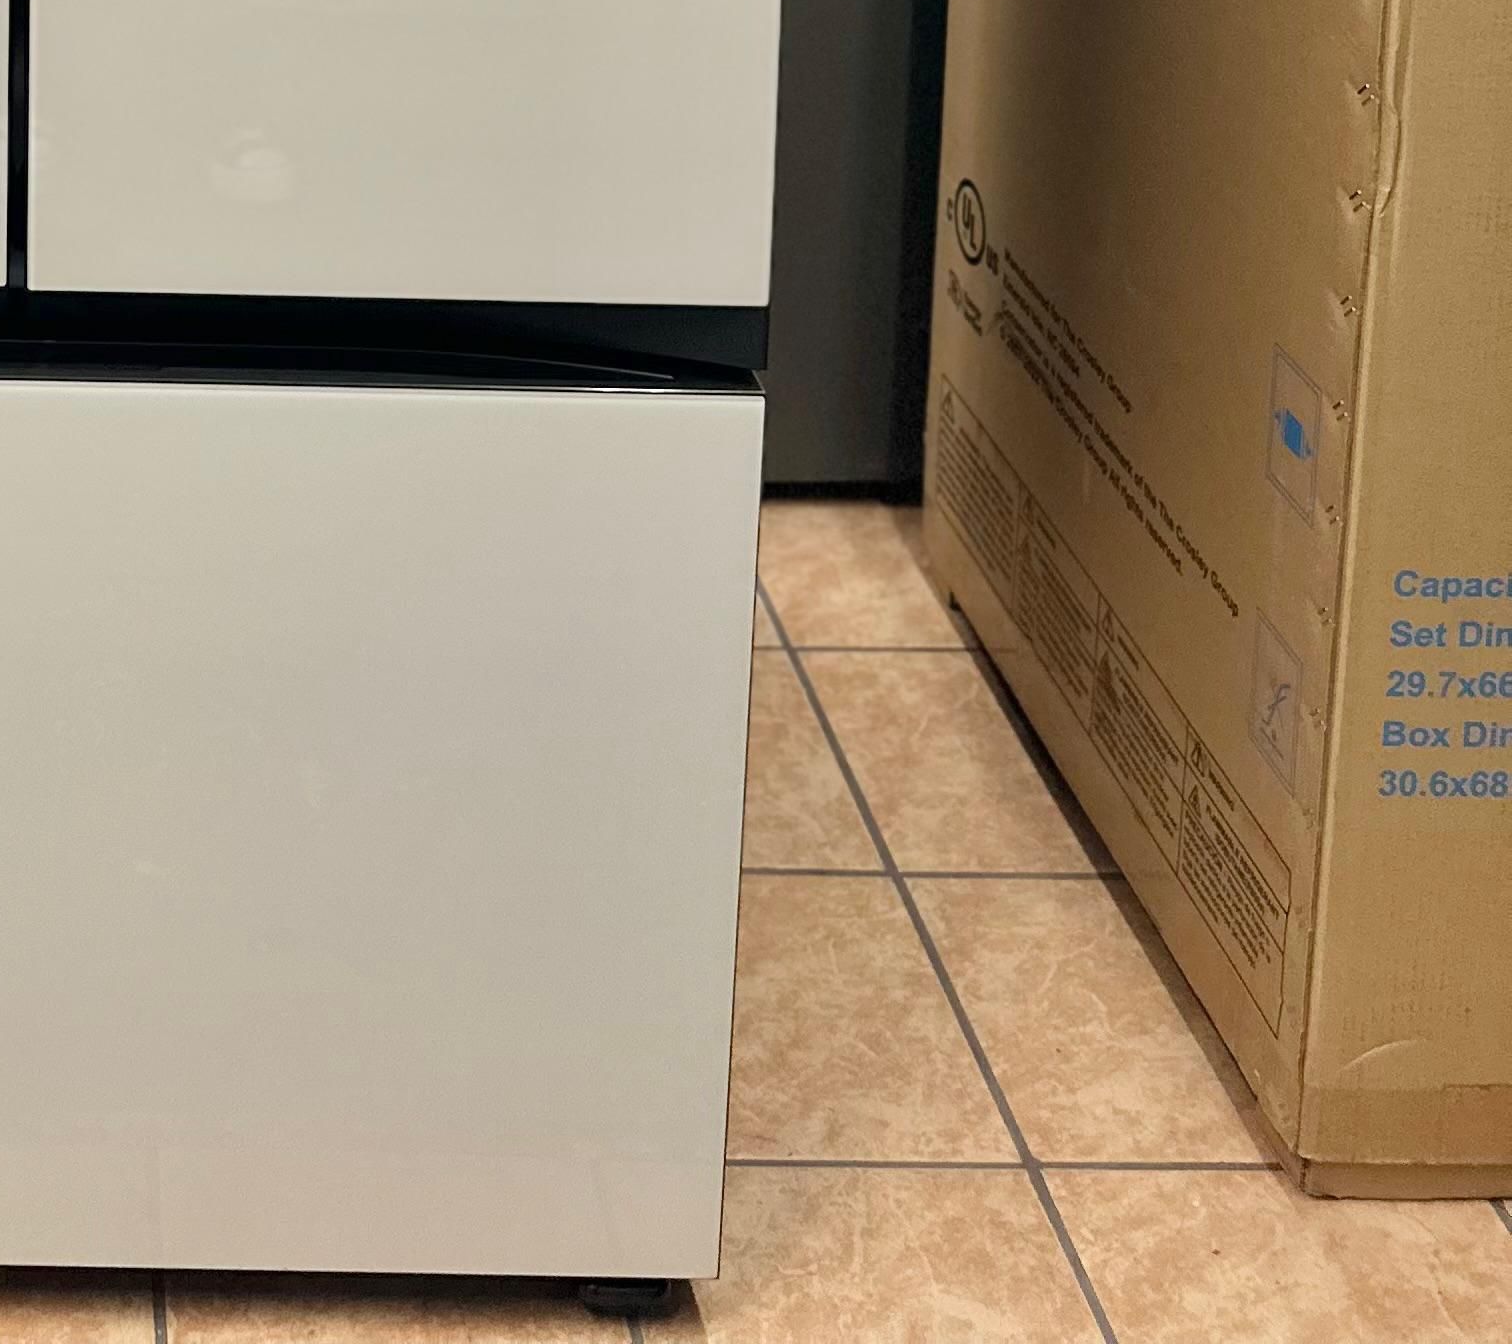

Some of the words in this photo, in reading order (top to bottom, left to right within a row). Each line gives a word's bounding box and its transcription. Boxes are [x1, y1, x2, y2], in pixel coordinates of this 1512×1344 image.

[1393, 570, 1512, 603] Capaci
[1389, 620, 1447, 647] Set
[1382, 720, 1450, 747] Box
